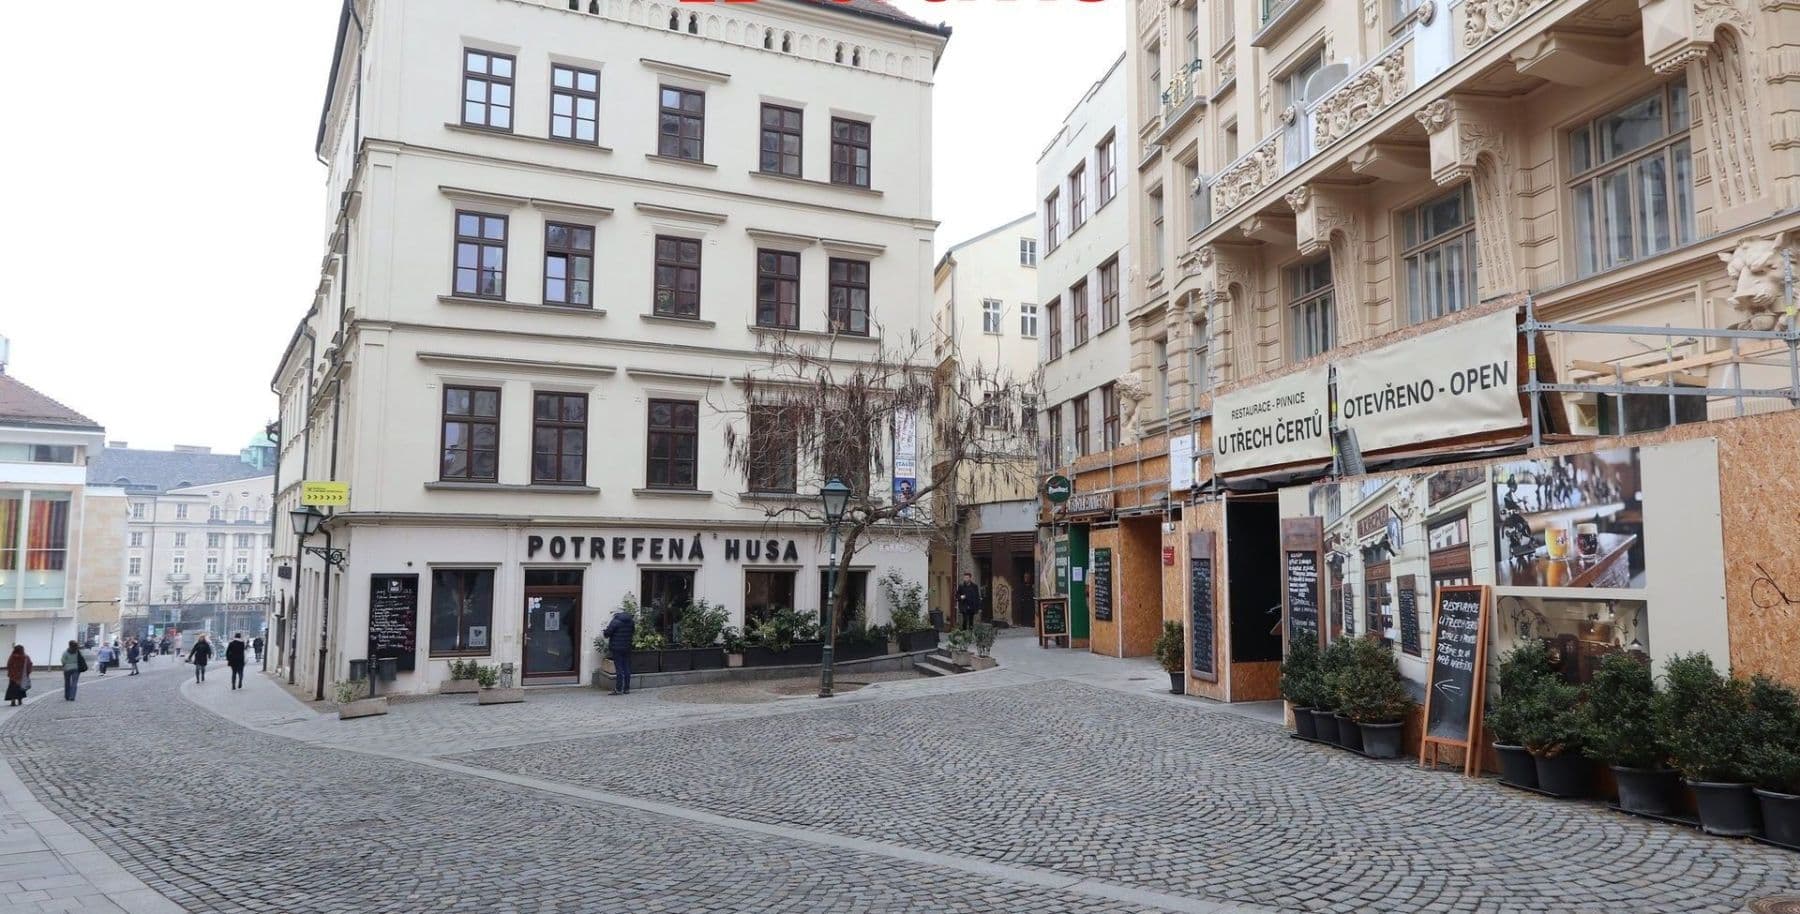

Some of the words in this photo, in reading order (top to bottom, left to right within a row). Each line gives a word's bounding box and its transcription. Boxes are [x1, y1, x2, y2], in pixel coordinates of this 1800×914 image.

[1231, 400, 1271, 420] RESTAURACE
[1276, 391, 1305, 408] PIVNICE
[1344, 379, 1434, 419] OTEVŘENO
[1451, 360, 1508, 396] OPEN
[1218, 435, 1228, 455] U
[1230, 427, 1273, 453] TŘECH
[1276, 408, 1323, 445] ČERTŮ
[527, 533, 705, 561] POTREFENÁ
[725, 538, 799, 562] HUSA
